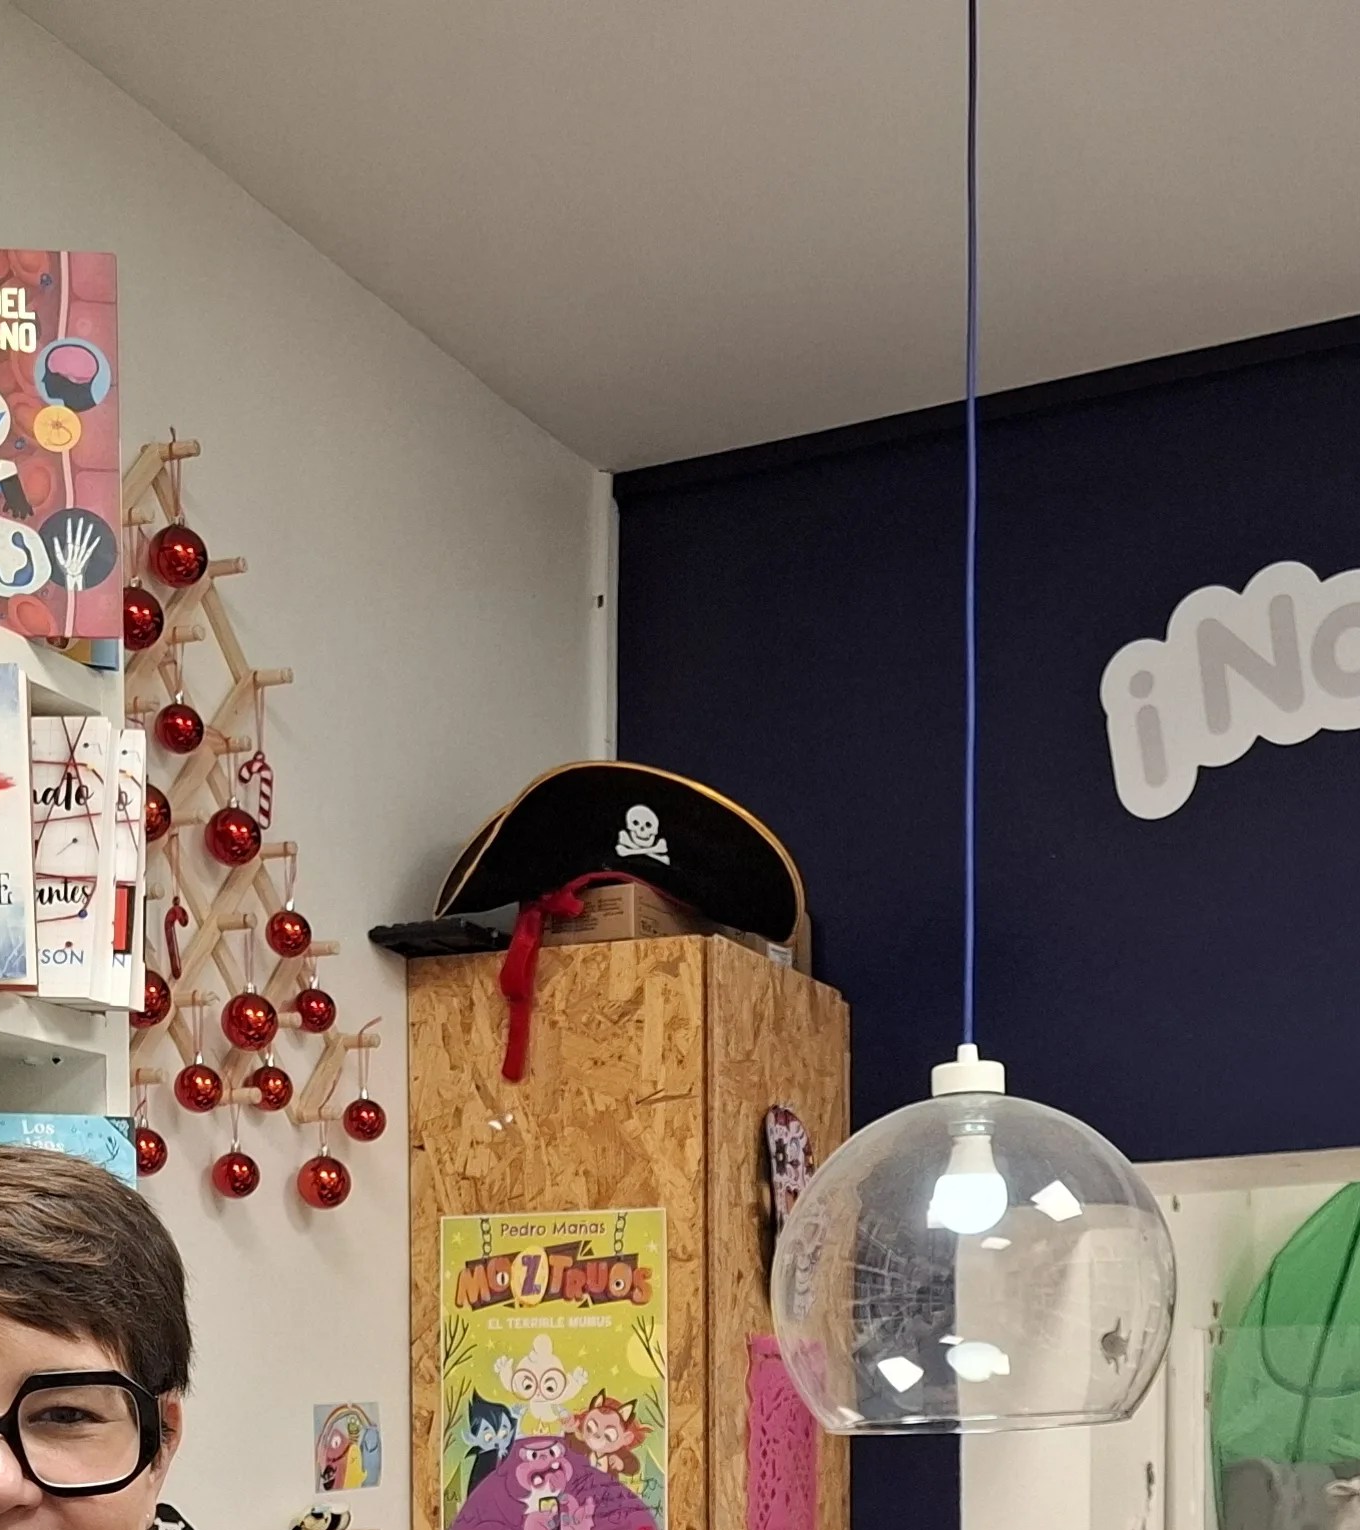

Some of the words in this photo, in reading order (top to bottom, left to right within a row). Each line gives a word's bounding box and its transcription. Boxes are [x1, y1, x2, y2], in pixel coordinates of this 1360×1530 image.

[20, 1118, 56, 1136] Los
[499, 1221, 547, 1237] Pedro
[552, 1220, 607, 1236] Mañas
[454, 1251, 654, 1311] MOZTRUOS
[506, 1316, 566, 1330] TERRIBLE
